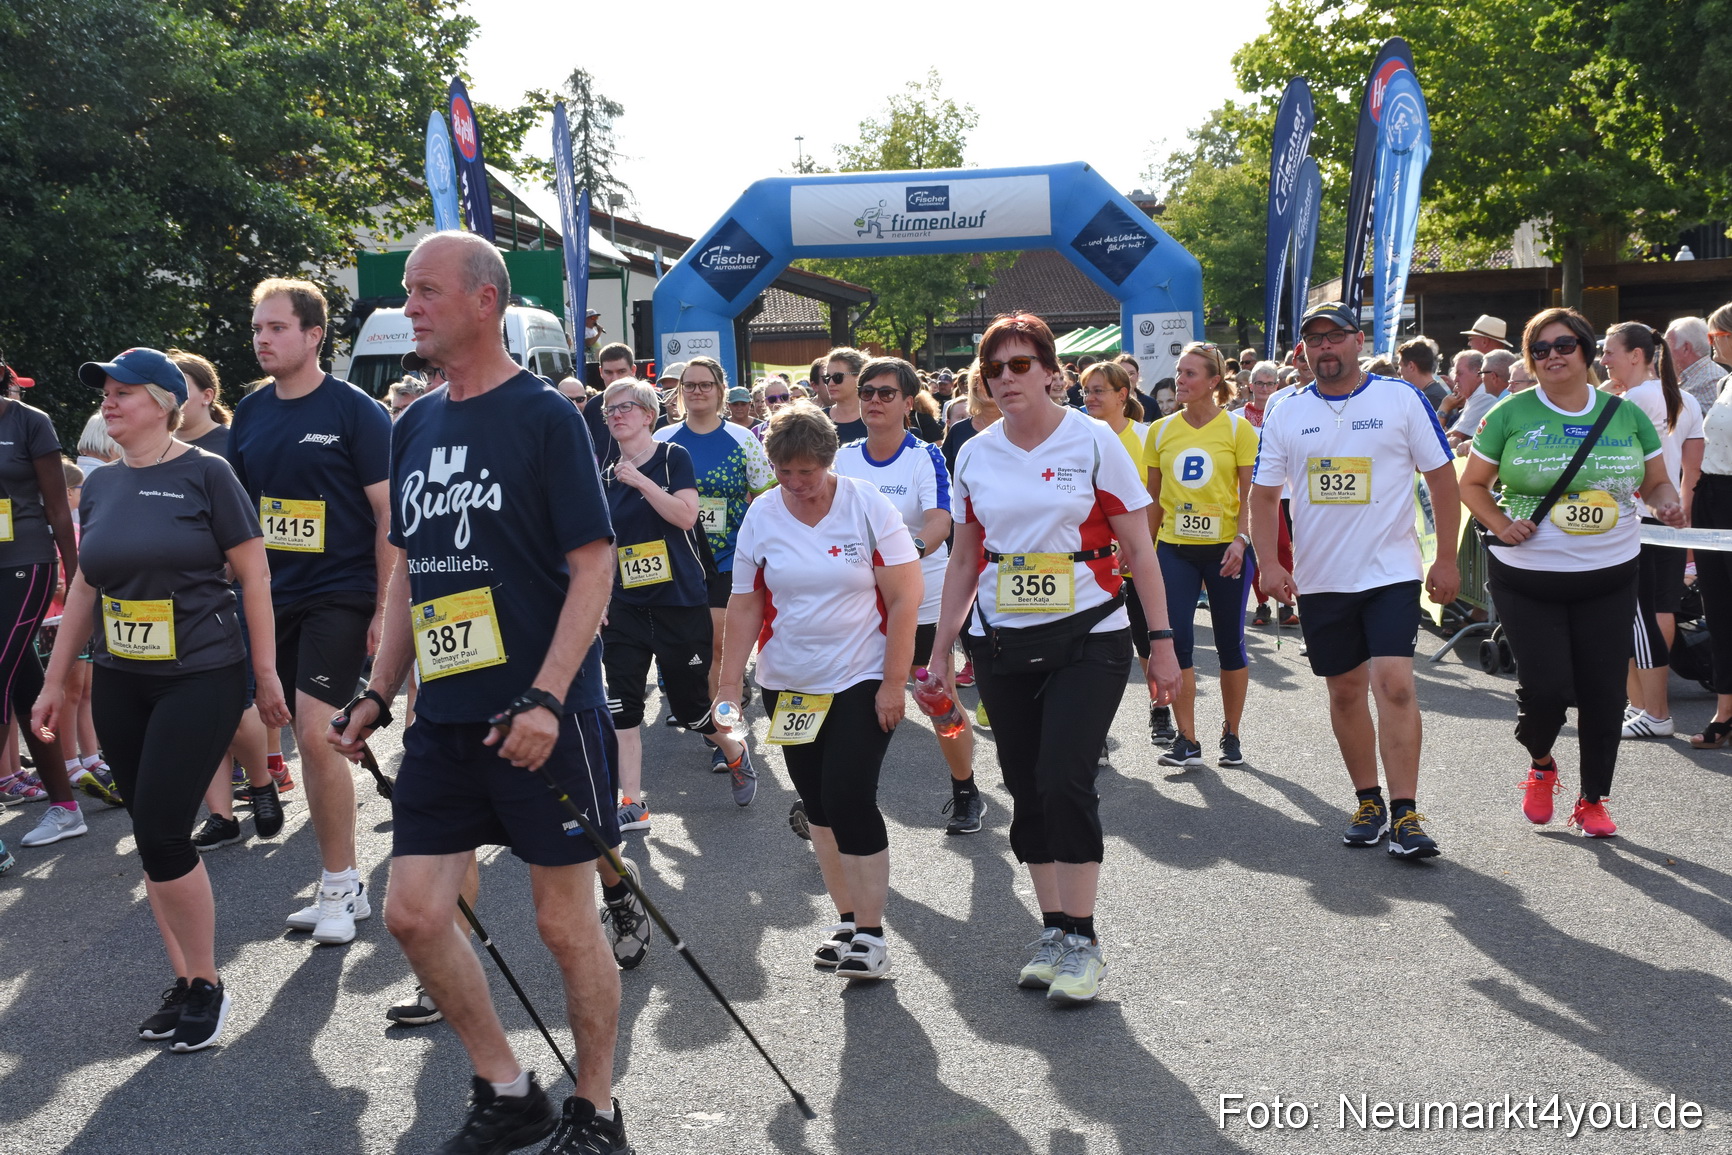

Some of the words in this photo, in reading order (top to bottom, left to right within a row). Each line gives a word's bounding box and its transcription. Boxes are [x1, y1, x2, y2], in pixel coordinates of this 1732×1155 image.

[1279, 103, 1302, 197] Fischer
[914, 195, 947, 204] Fischer
[891, 210, 987, 231] firmenlauf
[709, 253, 761, 266] Fischer
[366, 332, 409, 343] abavent
[1301, 426, 1321, 436] JAKO
[1351, 417, 1384, 431] GOSSNER
[1181, 455, 1205, 481] B
[879, 484, 908, 496] GOSSNER
[1056, 484, 1077, 494] Katja
[1320, 474, 1356, 491] 932
[402, 468, 502, 550] Burgis
[1565, 505, 1604, 524] 380
[266, 516, 315, 538] 1415
[1182, 515, 1211, 531] 350
[624, 556, 663, 577] 1433
[1011, 574, 1057, 597] 356
[113, 620, 153, 643] 177
[427, 620, 473, 657] 387
[132, 644, 161, 652] Angelika
[432, 654, 459, 666] Dietmayr
[460, 648, 479, 659] Paul
[783, 712, 816, 732] 360
